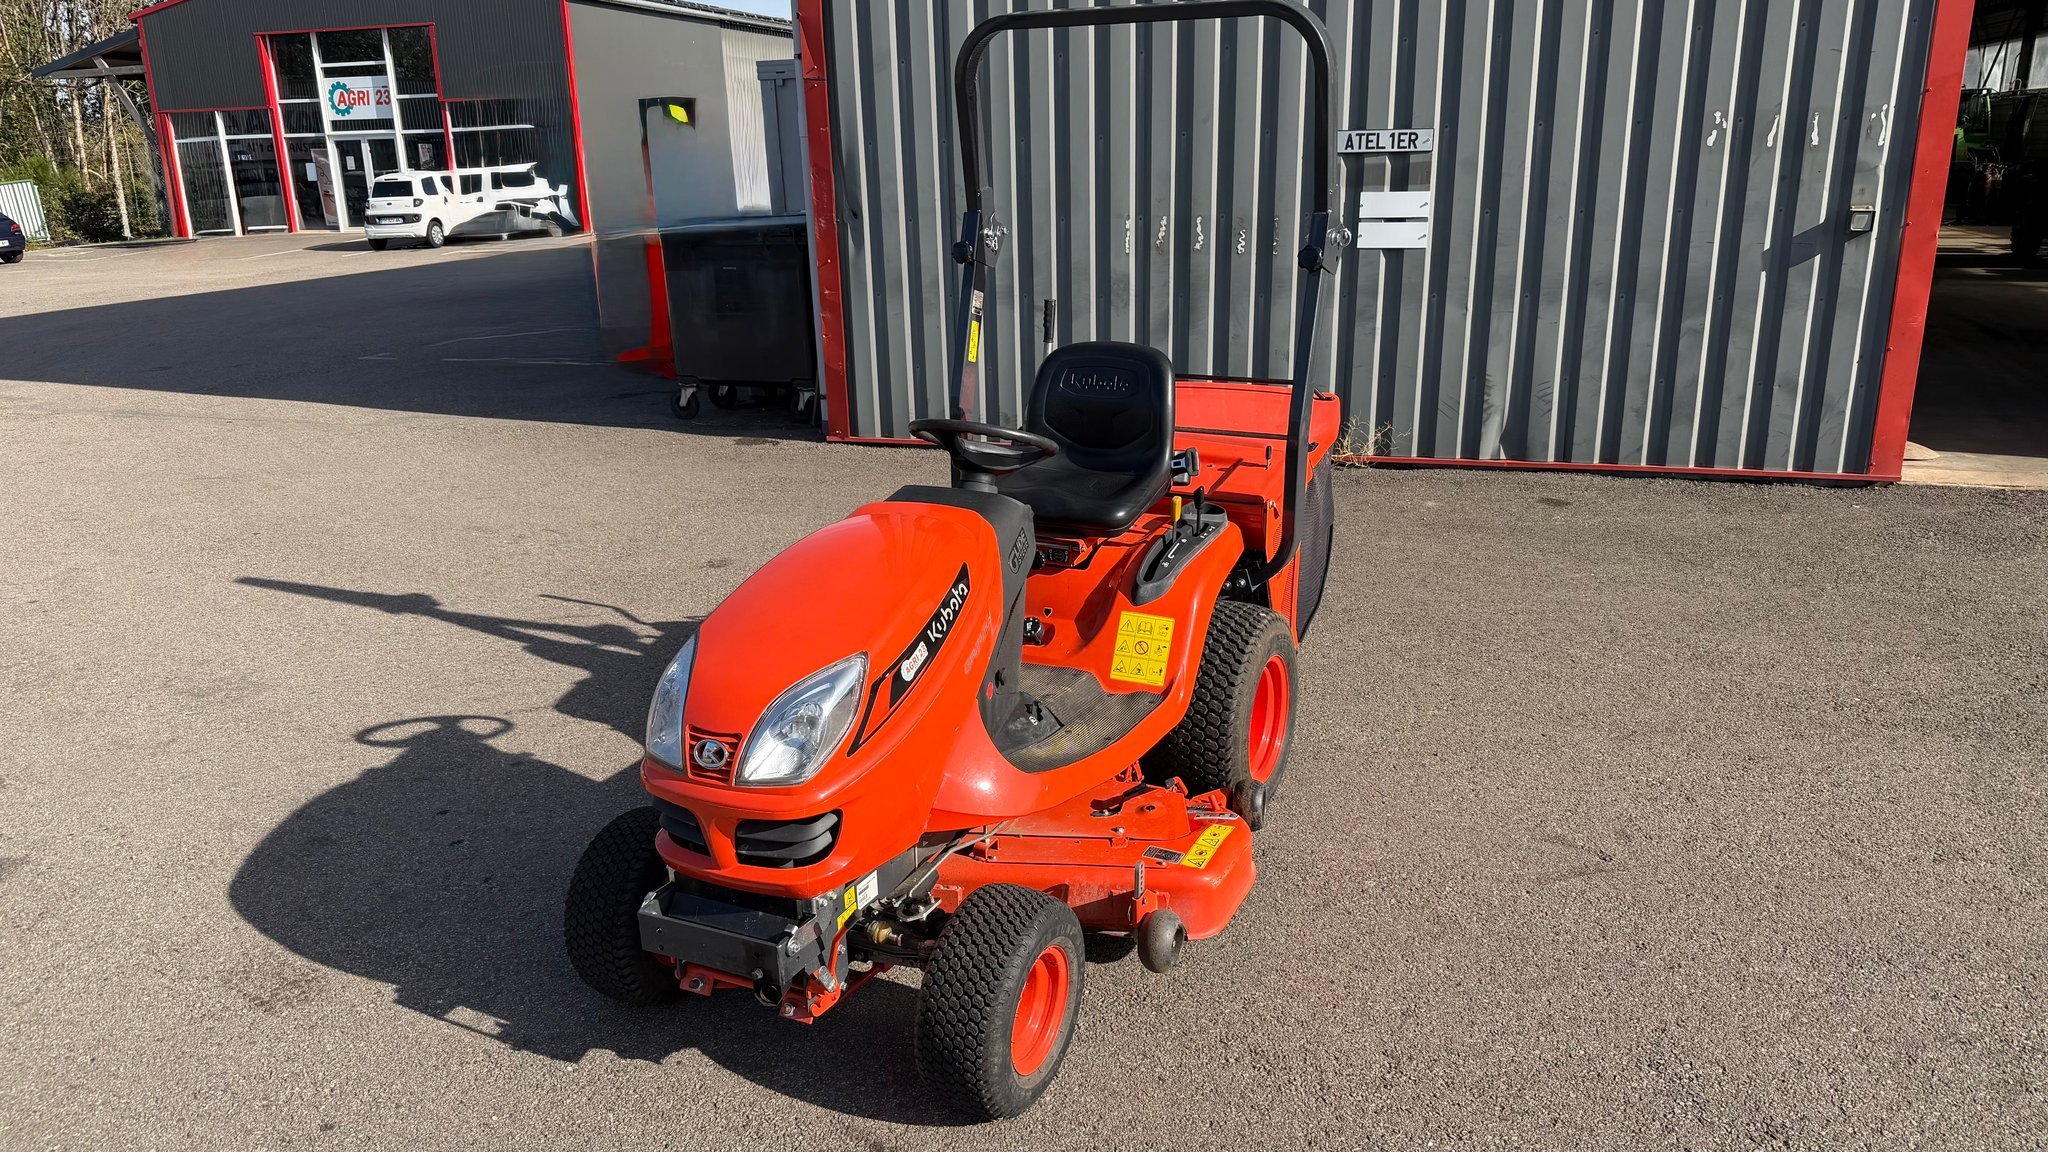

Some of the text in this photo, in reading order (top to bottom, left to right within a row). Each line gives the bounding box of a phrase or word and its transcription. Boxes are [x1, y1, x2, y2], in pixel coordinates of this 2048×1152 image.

[337, 89, 391, 107] AGRI 23
[927, 583, 969, 643] Kubota
[905, 653, 920, 675] AGRI
